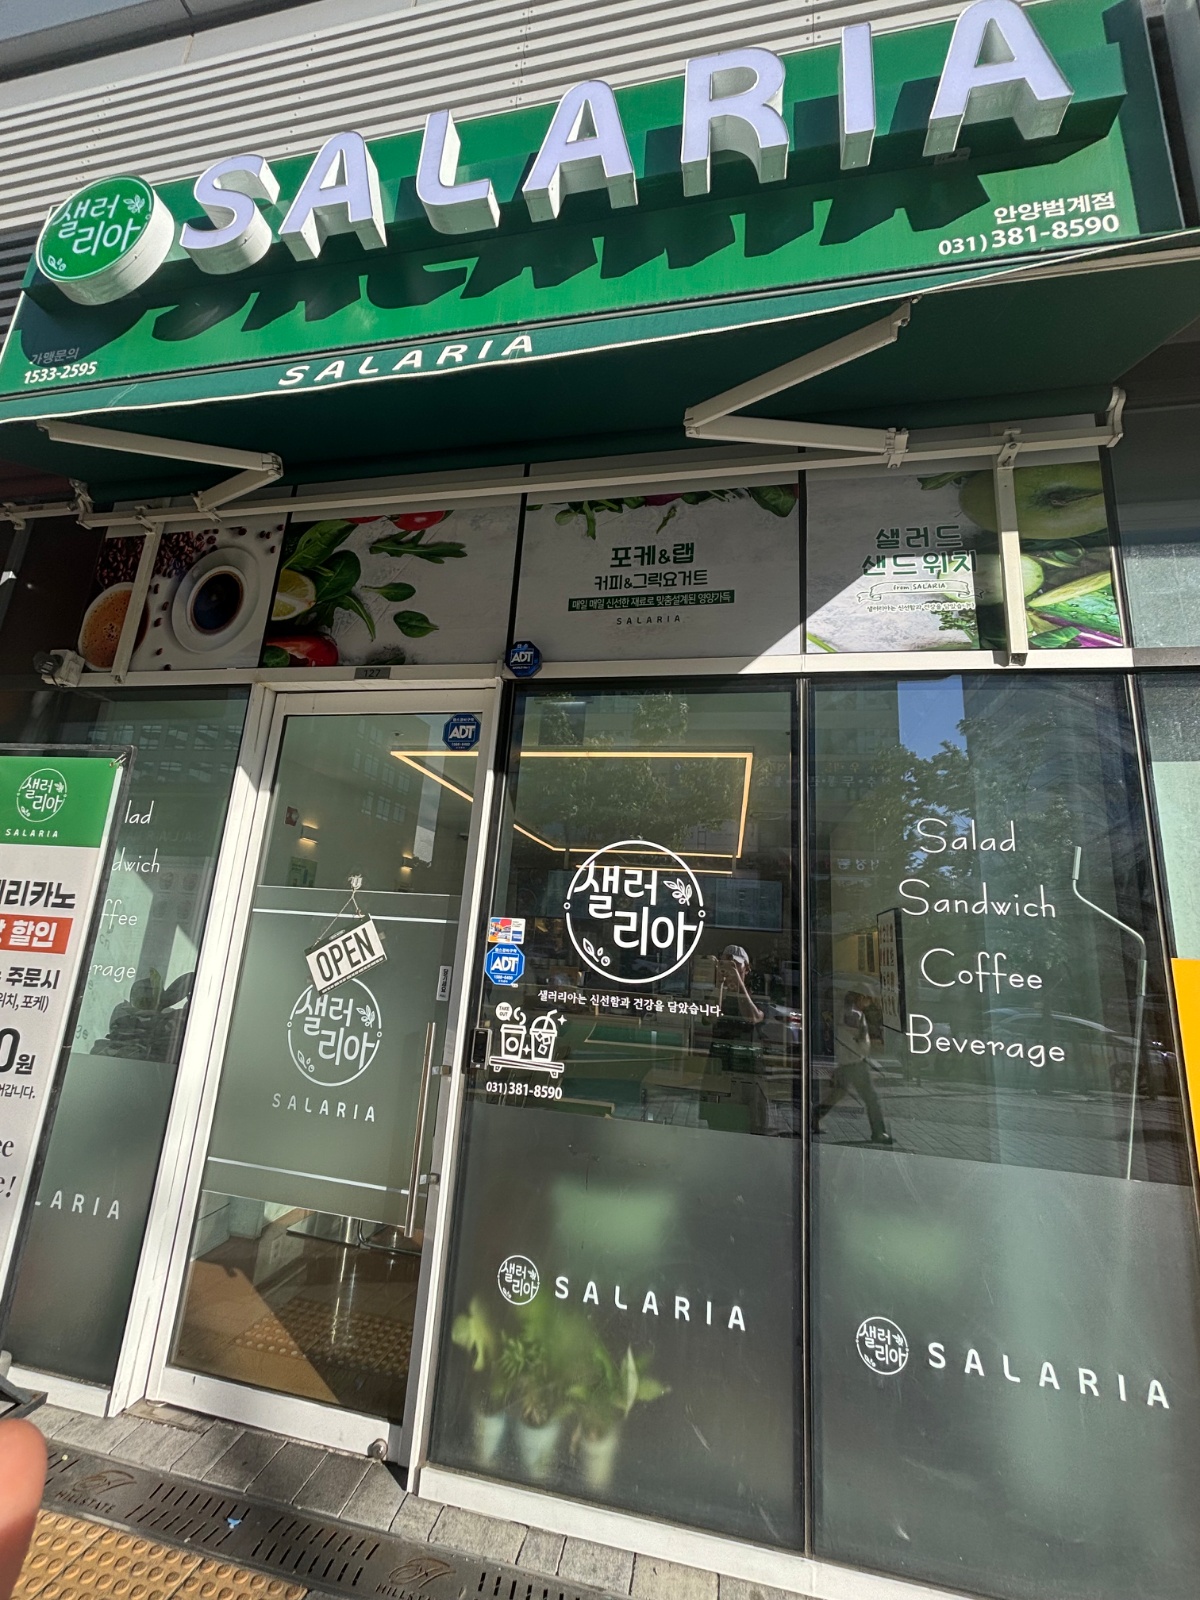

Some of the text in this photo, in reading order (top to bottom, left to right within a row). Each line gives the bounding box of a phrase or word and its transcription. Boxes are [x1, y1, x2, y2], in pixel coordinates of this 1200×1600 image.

[181, 0, 1073, 274] SALARIA
[52, 194, 120, 239] 샐러
[993, 191, 1115, 225] 안양범계점
[72, 218, 141, 256] 리아
[31, 347, 80, 364] 가맹문의
[278, 334, 534, 387] SALARIA
[23, 361, 98, 384] 1533-2595
[875, 525, 963, 549] 샐러드
[610, 542, 695, 568] 포케&랩
[861, 550, 977, 576] 샌드위치
[594, 569, 708, 590] 커피&그릭요거트
[572, 591, 732, 611] 매일 매일 신선한 재료로 맞춤설계된 영양가득
[616, 615, 681, 625] SALARIA
[511, 651, 534, 663] ADT
[363, 669, 382, 677] 127
[449, 725, 476, 739] ADT
[22, 777, 54, 799] 샐러
[32, 793, 62, 813] 리아
[5, 828, 59, 838] SALARIA
[917, 818, 1016, 853] Salad
[574, 861, 657, 918] 샐러
[899, 879, 1056, 918] Sandwich
[9, 919, 58, 948] 할인
[613, 906, 697, 961] 리아
[316, 927, 376, 982] OPEN
[491, 956, 519, 972] ADT
[6, 966, 61, 990] 주문시
[88, 963, 137, 983] rage
[921, 948, 1043, 994] Coffee
[21, 995, 50, 1013] 포케)
[295, 989, 354, 1036] 샐러
[538, 989, 724, 1018] 샐러리아는 신선함과 건강을 담았습니다.
[318, 1027, 376, 1070] 리아
[906, 1014, 1065, 1068] Beverage
[272, 1093, 376, 1122] SALARIA
[35, 1190, 119, 1220] ARIA
[501, 1262, 527, 1282] 샐러
[511, 1279, 537, 1298] 리아
[554, 1276, 746, 1331] SALARIA
[859, 1324, 891, 1348] 샐러
[874, 1345, 906, 1367] 리아
[928, 1342, 1169, 1409] SALARIA
